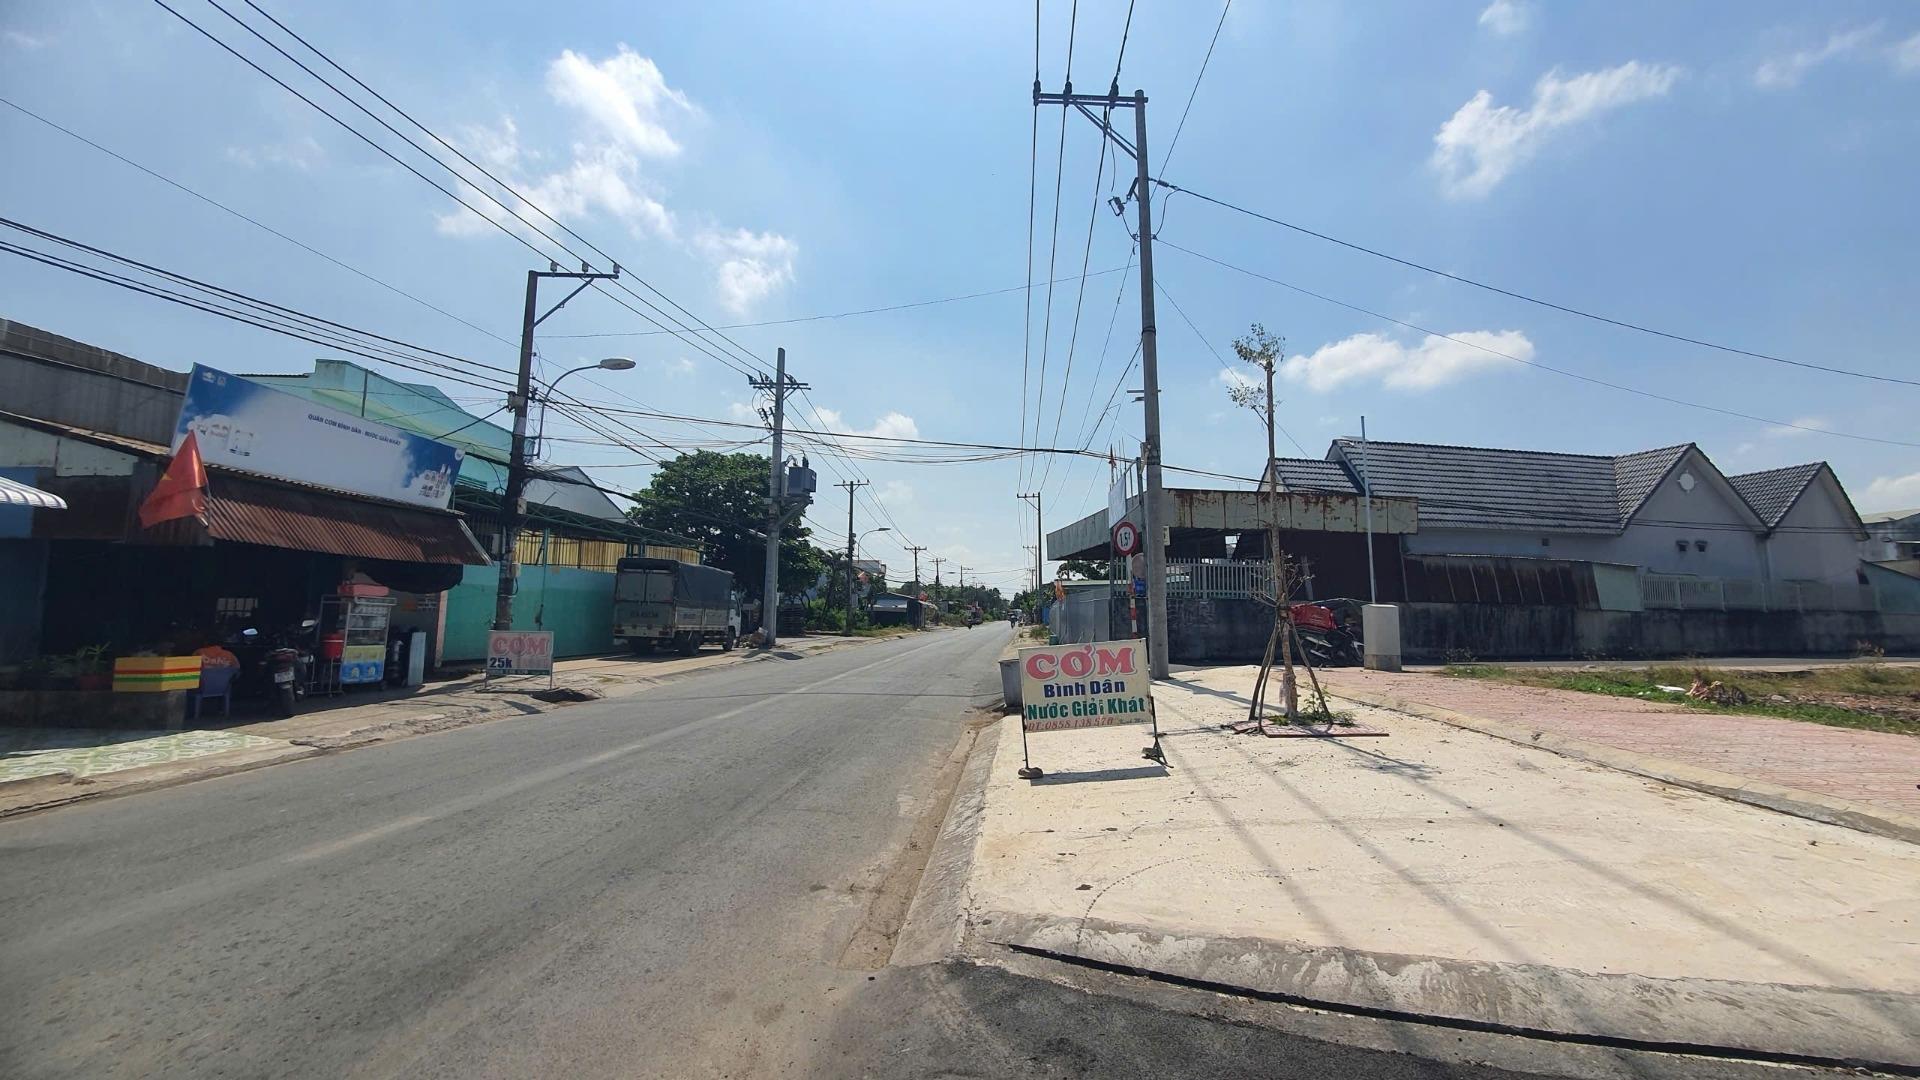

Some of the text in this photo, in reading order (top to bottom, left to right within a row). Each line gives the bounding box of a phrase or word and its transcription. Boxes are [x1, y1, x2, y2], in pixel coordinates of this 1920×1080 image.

[492, 634, 547, 656] CƠM
[1026, 643, 1136, 680] CƠM
[1043, 678, 1126, 698] Bình Dân
[1026, 696, 1146, 720] Nước Giải Khát
